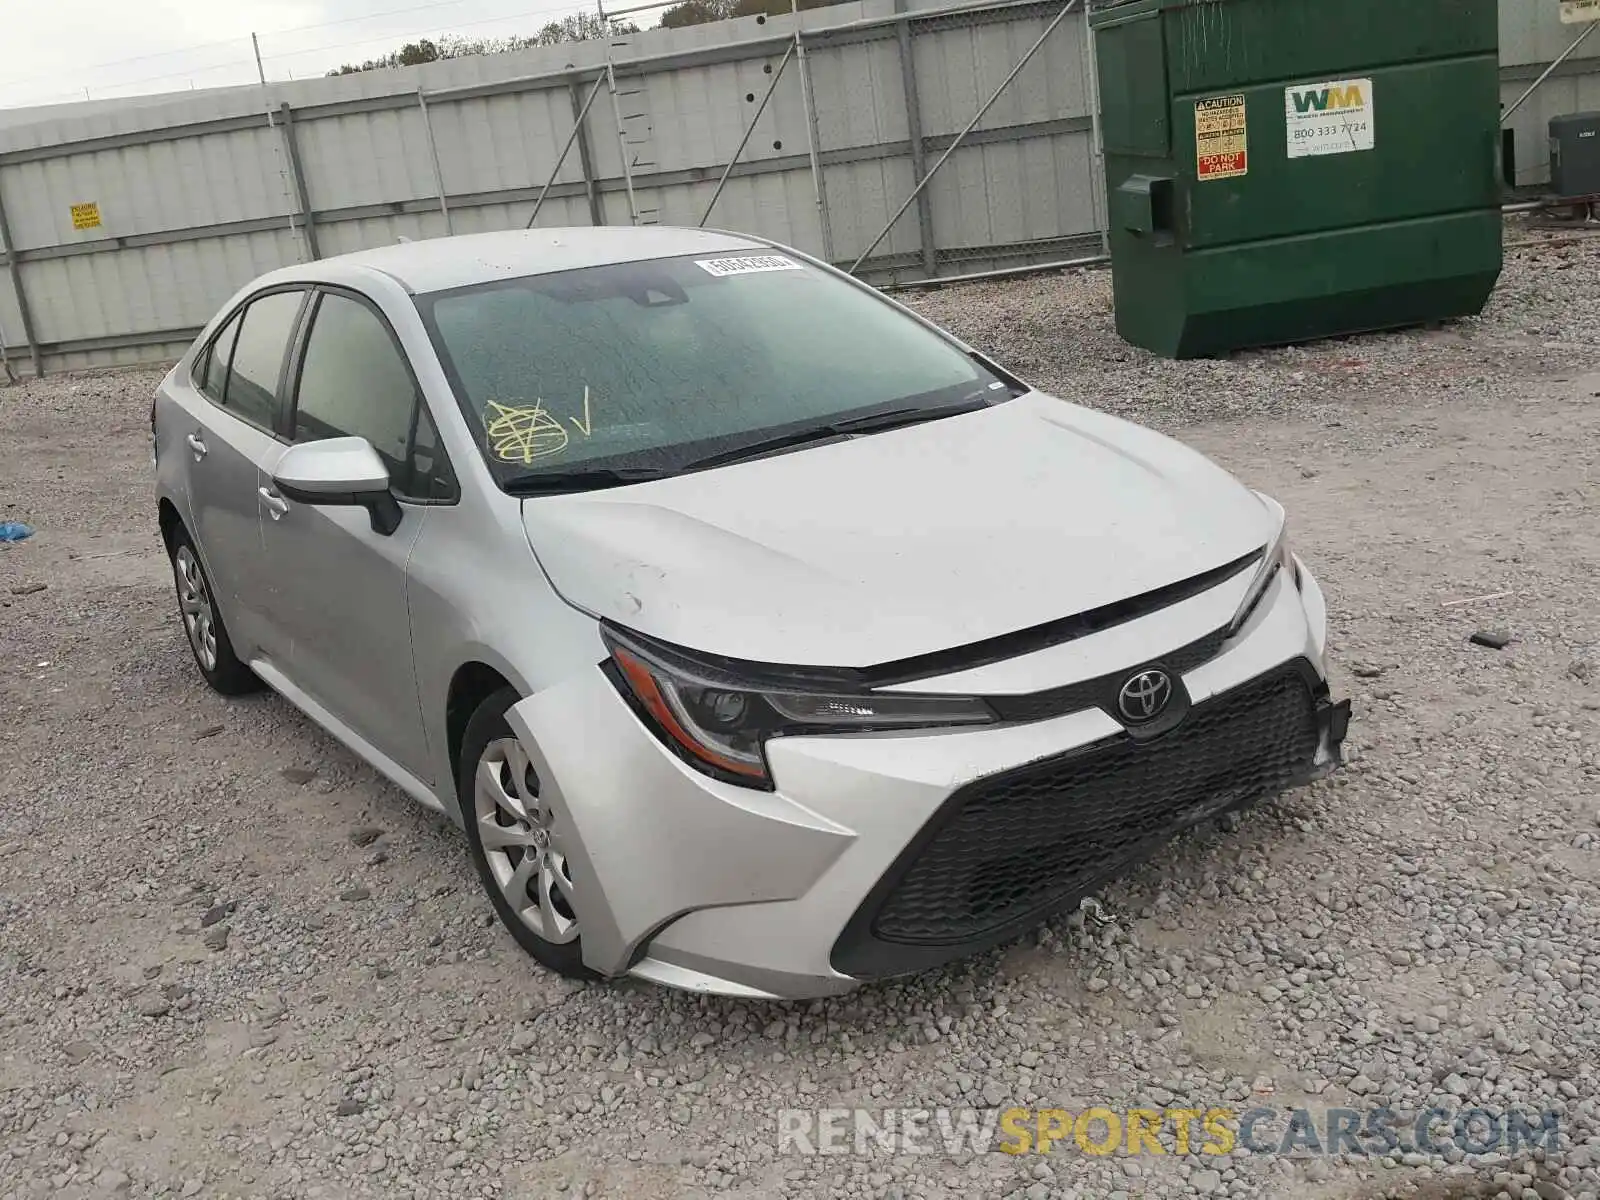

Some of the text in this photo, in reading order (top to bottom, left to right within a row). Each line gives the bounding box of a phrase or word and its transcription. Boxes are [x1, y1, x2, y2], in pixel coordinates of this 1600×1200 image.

[1205, 97, 1243, 109] CAUTION
[1291, 85, 1364, 112] WM
[1295, 120, 1367, 139] 800 333 7724
[1204, 152, 1241, 165] DO NOT
[1210, 162, 1236, 173] PARK
